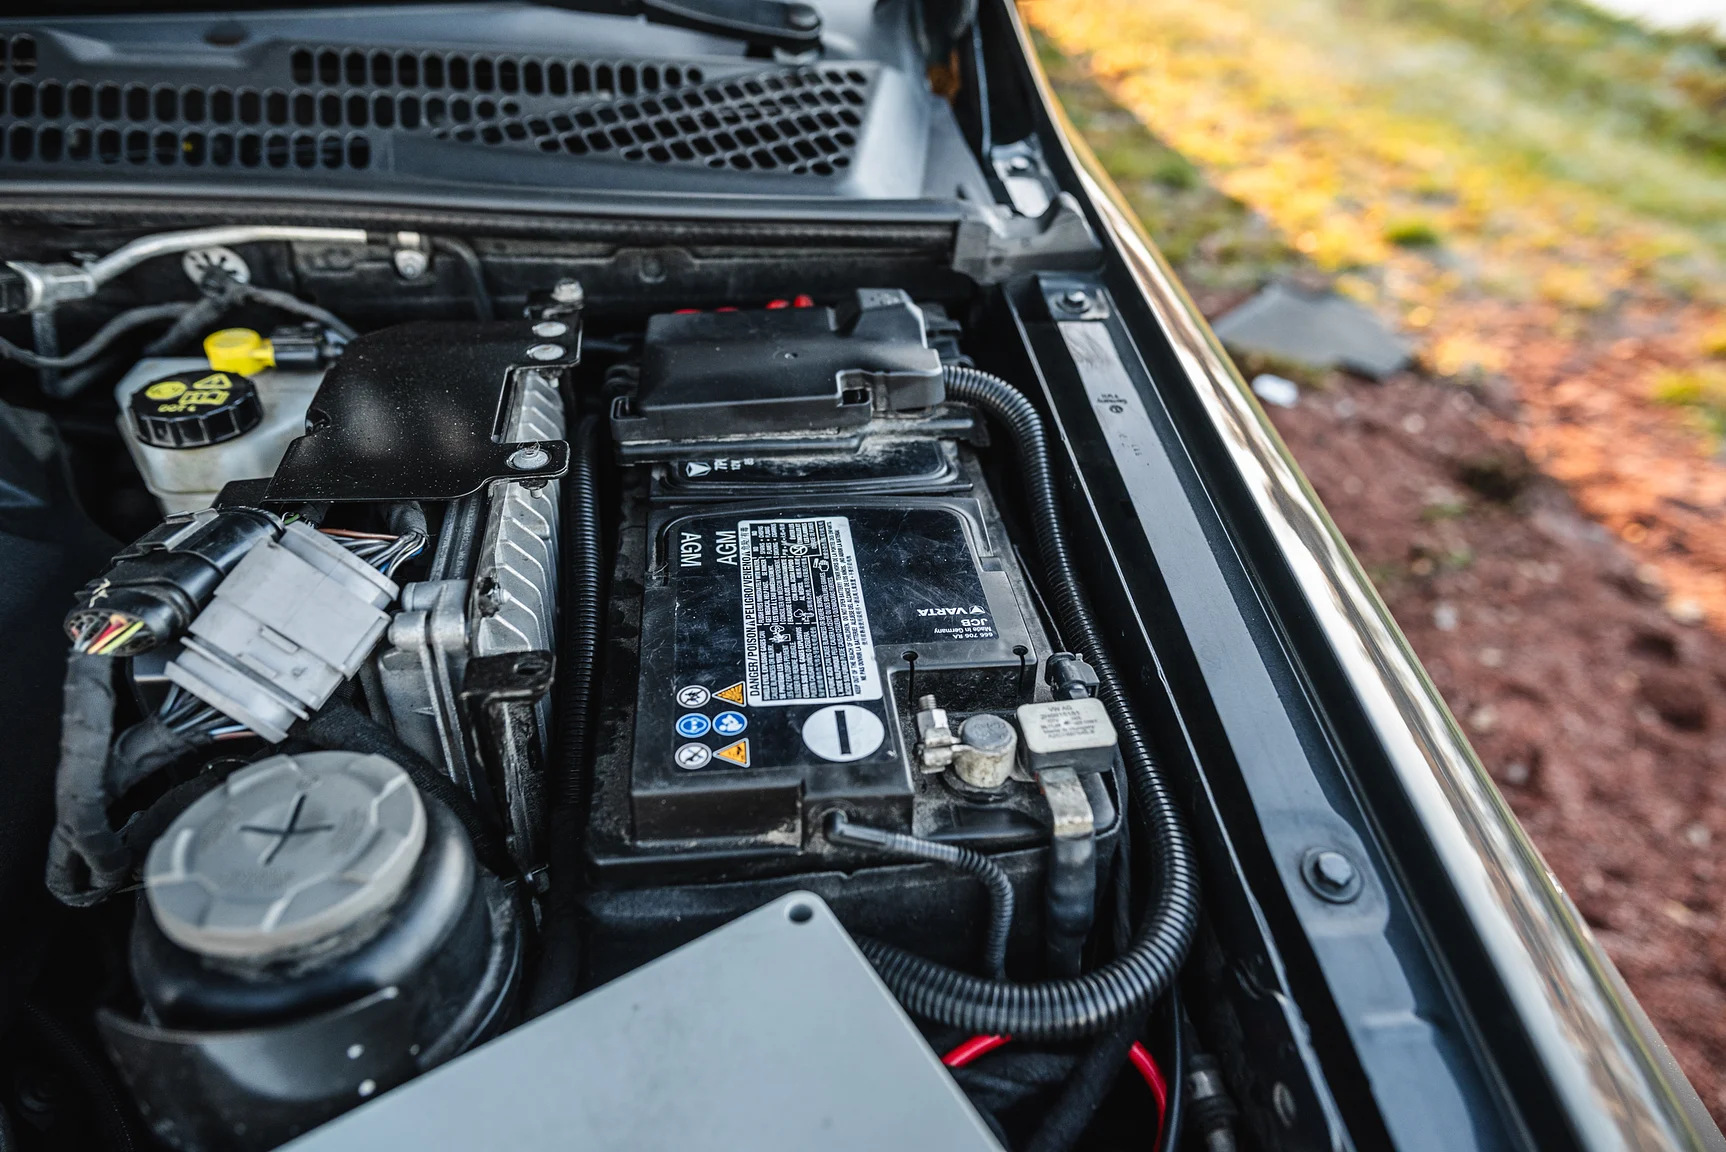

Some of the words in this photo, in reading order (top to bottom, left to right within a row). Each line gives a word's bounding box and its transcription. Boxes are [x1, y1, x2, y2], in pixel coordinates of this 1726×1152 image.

[681, 532, 702, 567] AGM
[716, 531, 737, 565] AGM
[917, 607, 968, 616] VARTA
[961, 618, 988, 626] JCB
